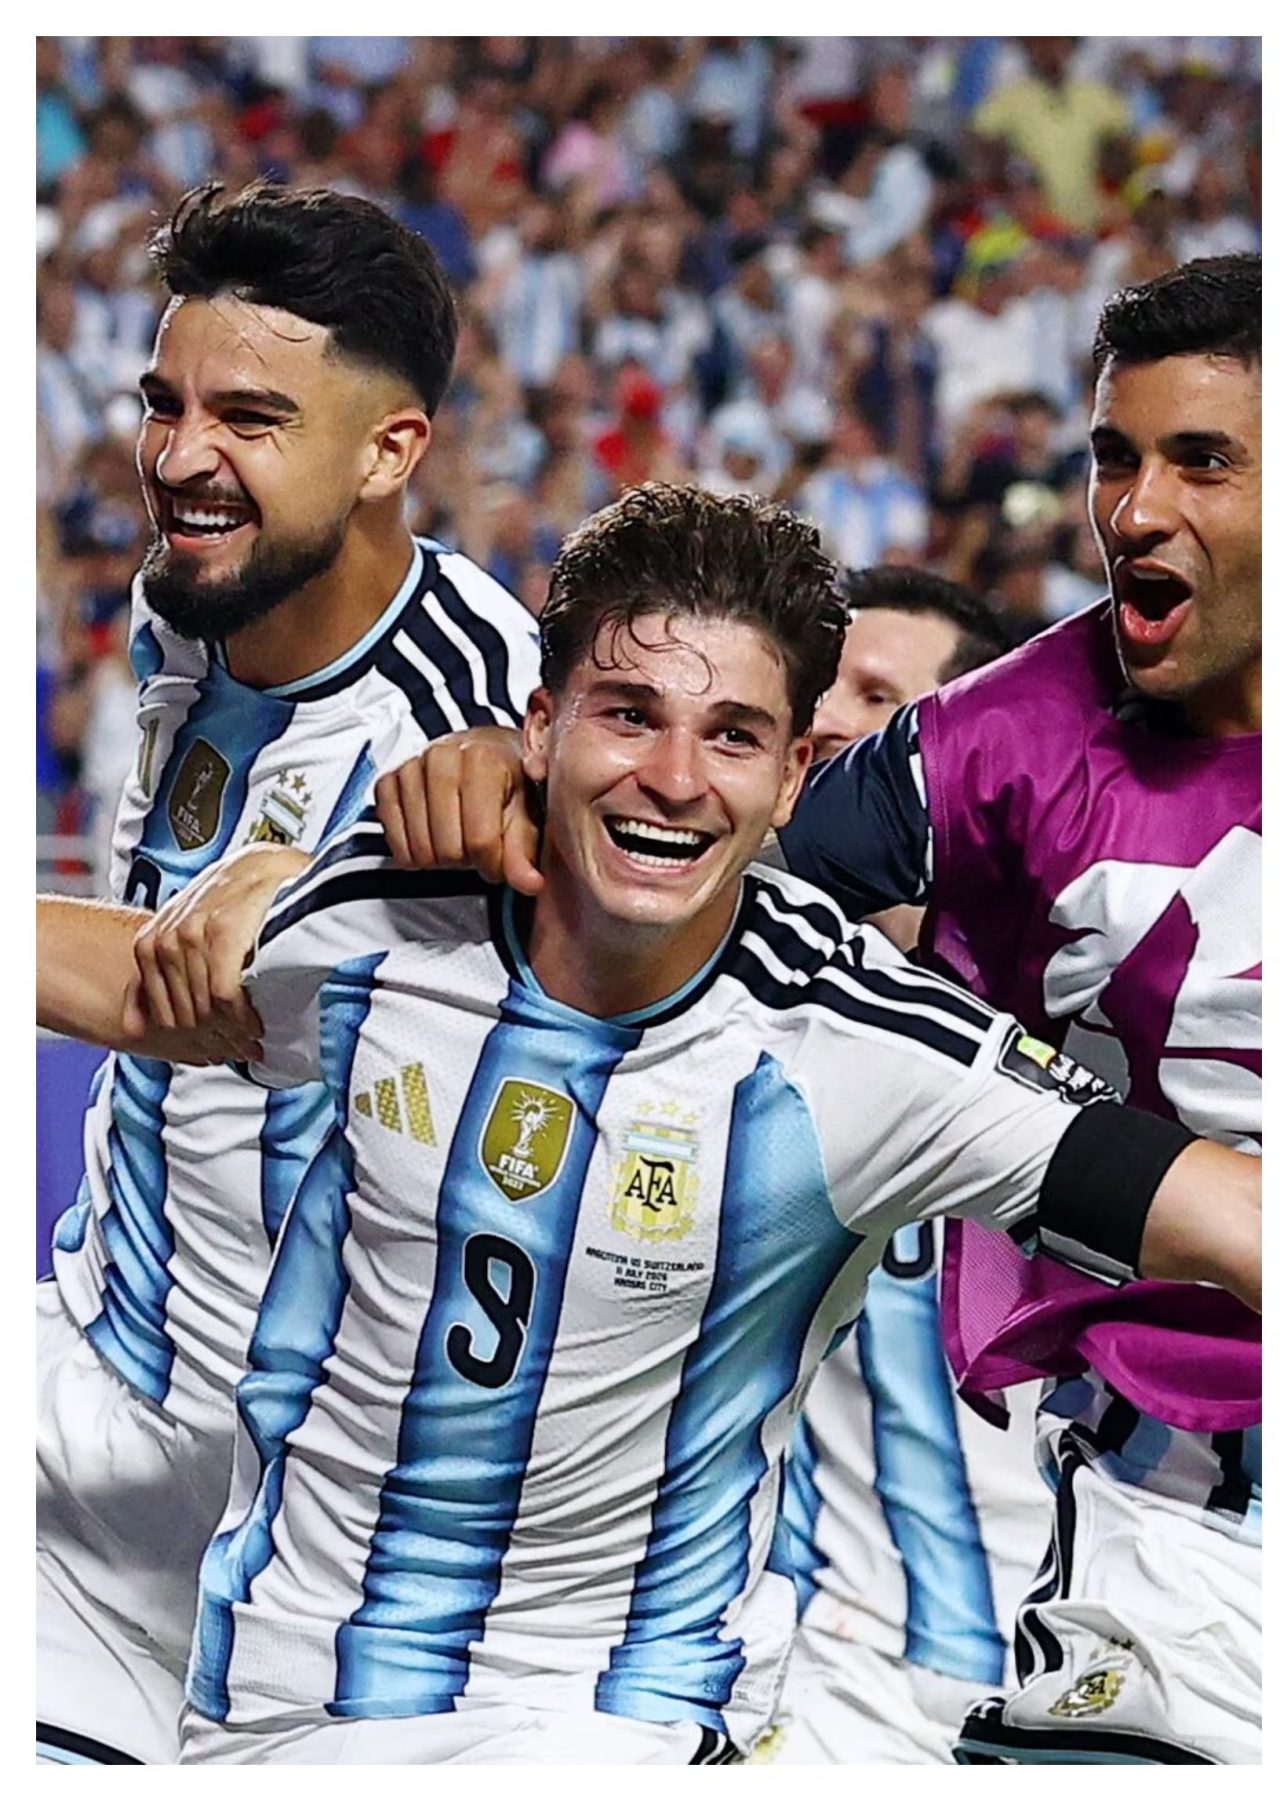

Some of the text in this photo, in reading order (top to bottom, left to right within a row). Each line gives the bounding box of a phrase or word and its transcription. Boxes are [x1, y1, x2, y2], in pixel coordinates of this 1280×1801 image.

[177, 805, 200, 833] FIFA
[498, 1153, 535, 1179] FIFA
[624, 1155, 678, 1212] AFA
[585, 1246, 628, 1264] ARGENTINA
[643, 1259, 705, 1272] SWITZERLAND
[613, 1277, 668, 1292] KANSAS CITY
[624, 1268, 643, 1279] JULY
[445, 1232, 536, 1390] 9
